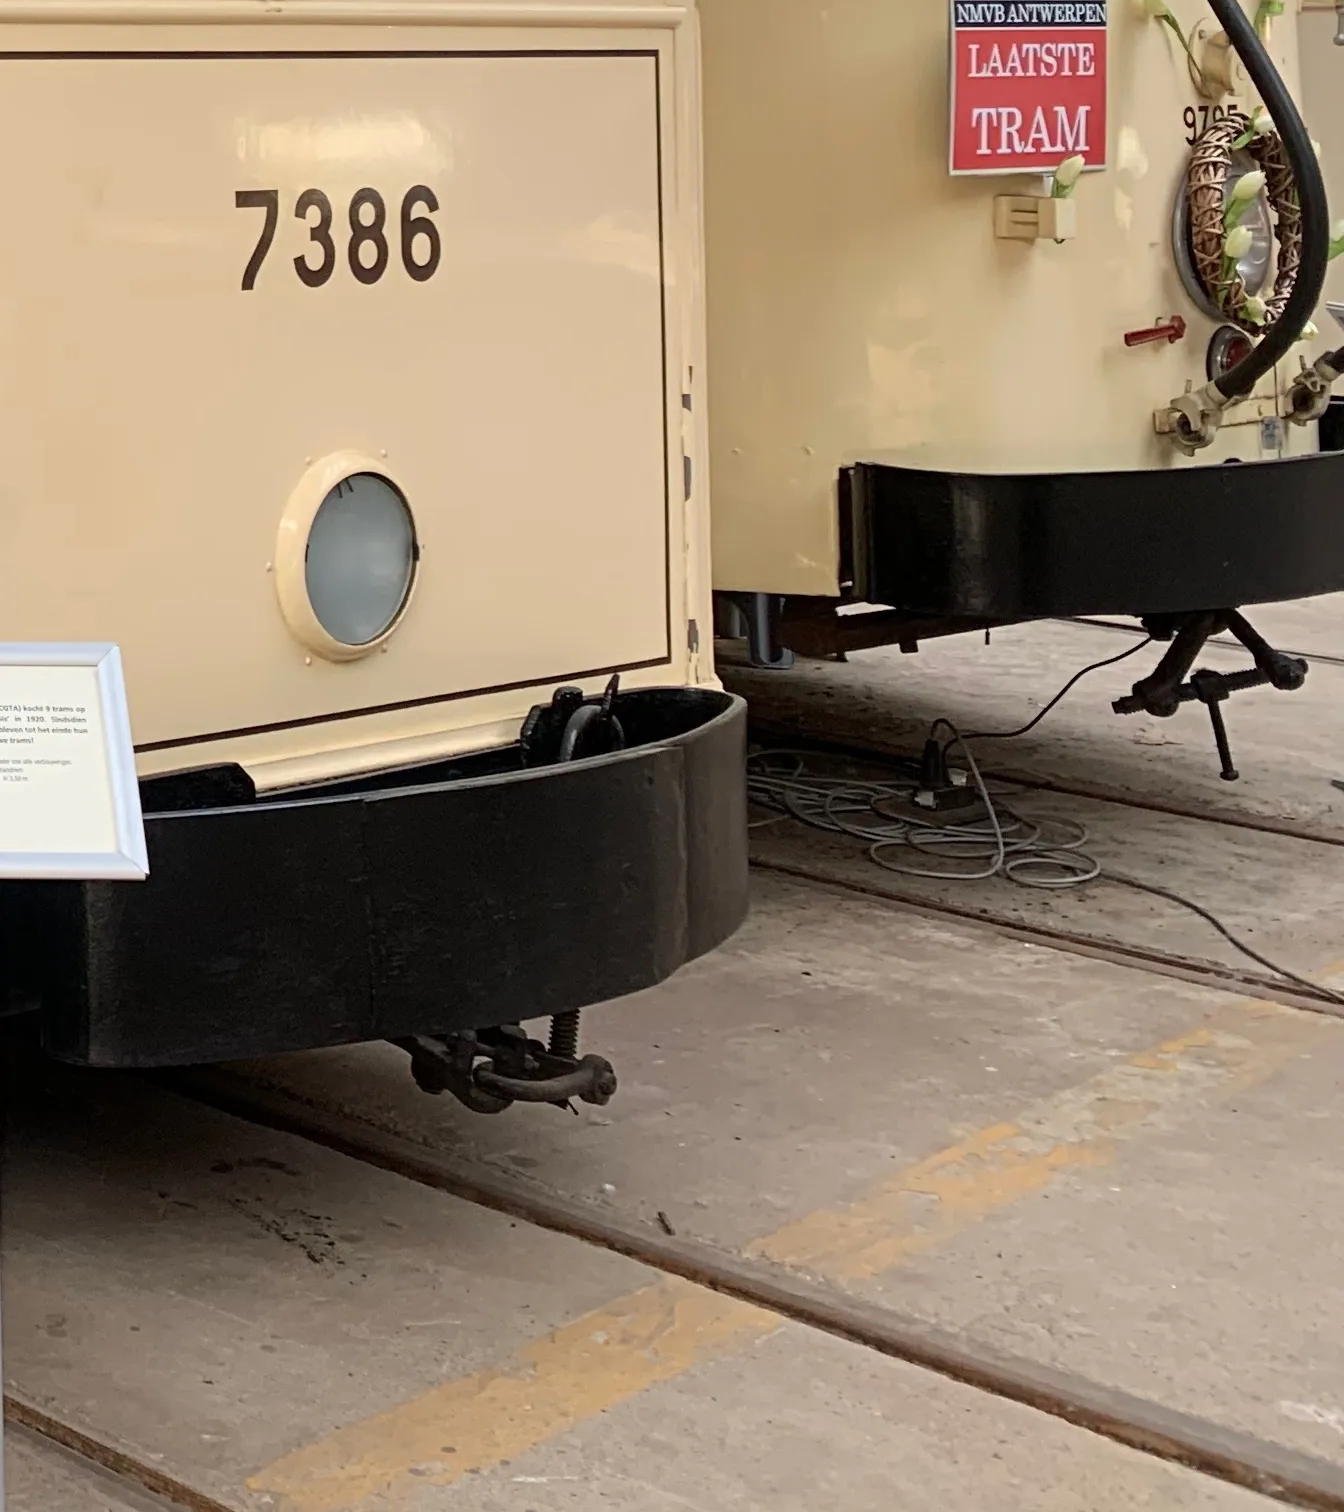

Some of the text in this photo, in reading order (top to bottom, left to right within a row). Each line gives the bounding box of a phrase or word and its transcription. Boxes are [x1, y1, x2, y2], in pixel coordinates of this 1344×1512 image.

[956, 2, 1108, 24] NMVB ANTWERPEN
[967, 42, 1096, 79] LAATSTE
[971, 105, 1091, 156] TRAM
[234, 184, 443, 292] 7386
[23, 705, 44, 713] kocht
